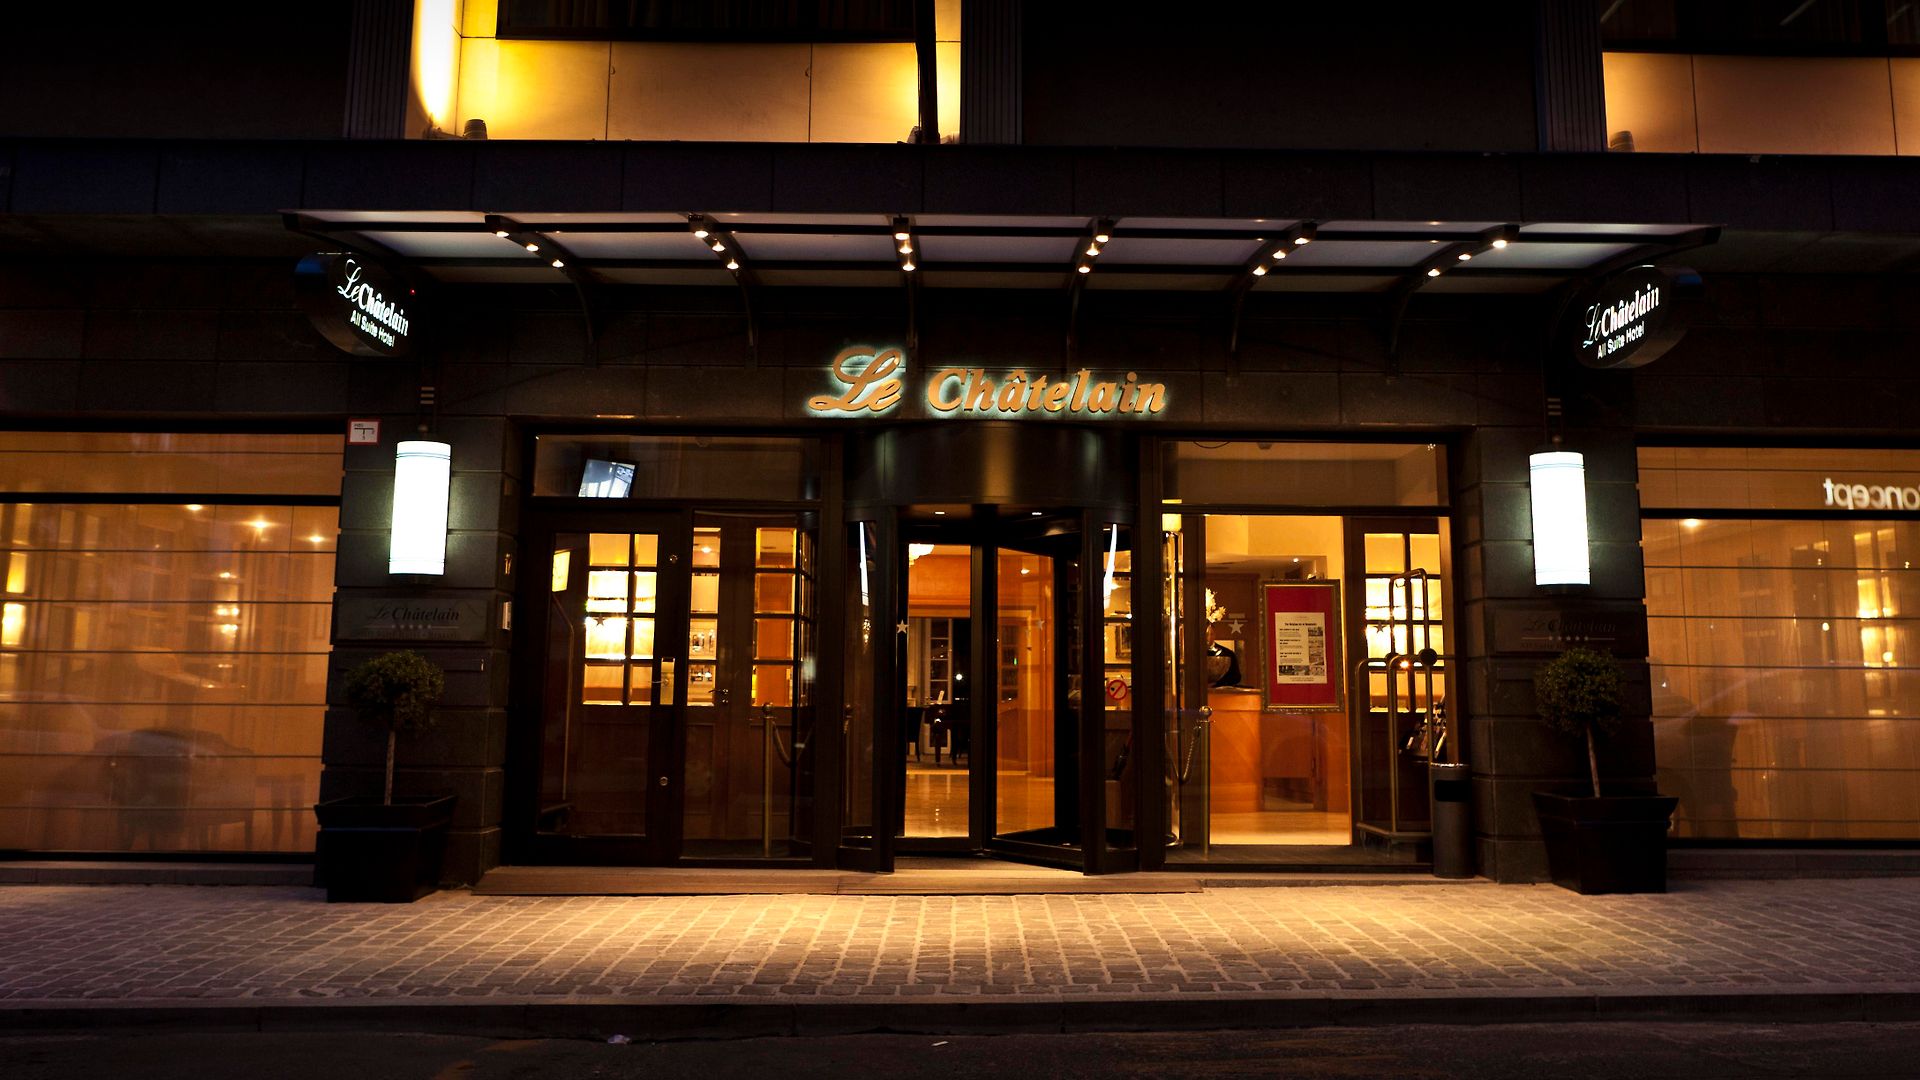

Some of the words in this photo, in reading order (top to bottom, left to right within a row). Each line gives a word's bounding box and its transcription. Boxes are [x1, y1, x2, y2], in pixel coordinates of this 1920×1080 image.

[337, 259, 362, 303] Le
[358, 283, 409, 337] Châtelain
[1601, 282, 1660, 338] Châtelain
[350, 310, 361, 327] All
[361, 315, 378, 338] Suite
[378, 326, 395, 348] Hotel
[1597, 344, 1607, 360] All
[1607, 334, 1626, 355] Suite
[1626, 320, 1645, 344] Hotel
[807, 346, 903, 412] Le
[927, 367, 1167, 414] Châtelain
[391, 606, 460, 622] Châtelain
